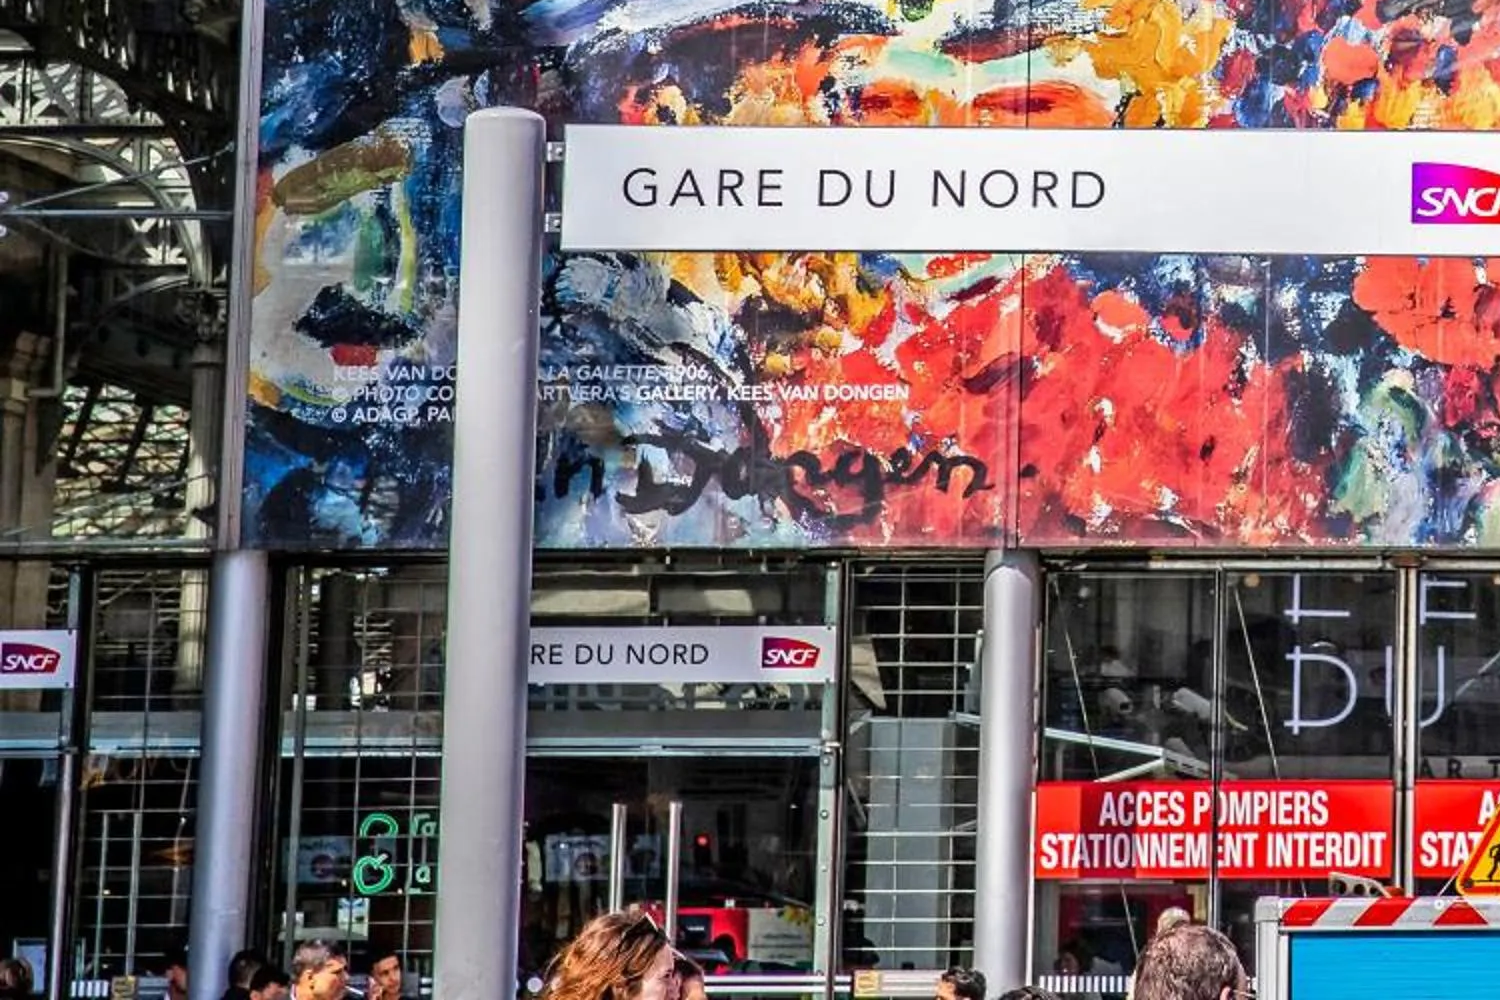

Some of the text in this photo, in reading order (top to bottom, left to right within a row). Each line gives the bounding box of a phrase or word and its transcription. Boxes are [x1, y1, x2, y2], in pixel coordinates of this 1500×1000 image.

[621, 166, 1108, 210] GARE DU NORD
[334, 366, 379, 381] KEES
[386, 367, 425, 381] VAN
[546, 365, 570, 381] LA
[352, 386, 423, 401] PHOTO
[727, 385, 773, 400] KEES
[780, 385, 820, 400] VAN
[824, 384, 911, 400] DONGEN
[2, 653, 58, 673] SNCF
[530, 643, 709, 665] RE DU NORD
[764, 648, 816, 666] SNCF
[1099, 790, 1329, 826] ACCES POMPIERS
[1040, 831, 1387, 869] STATIONNEMENT INTERDIT
